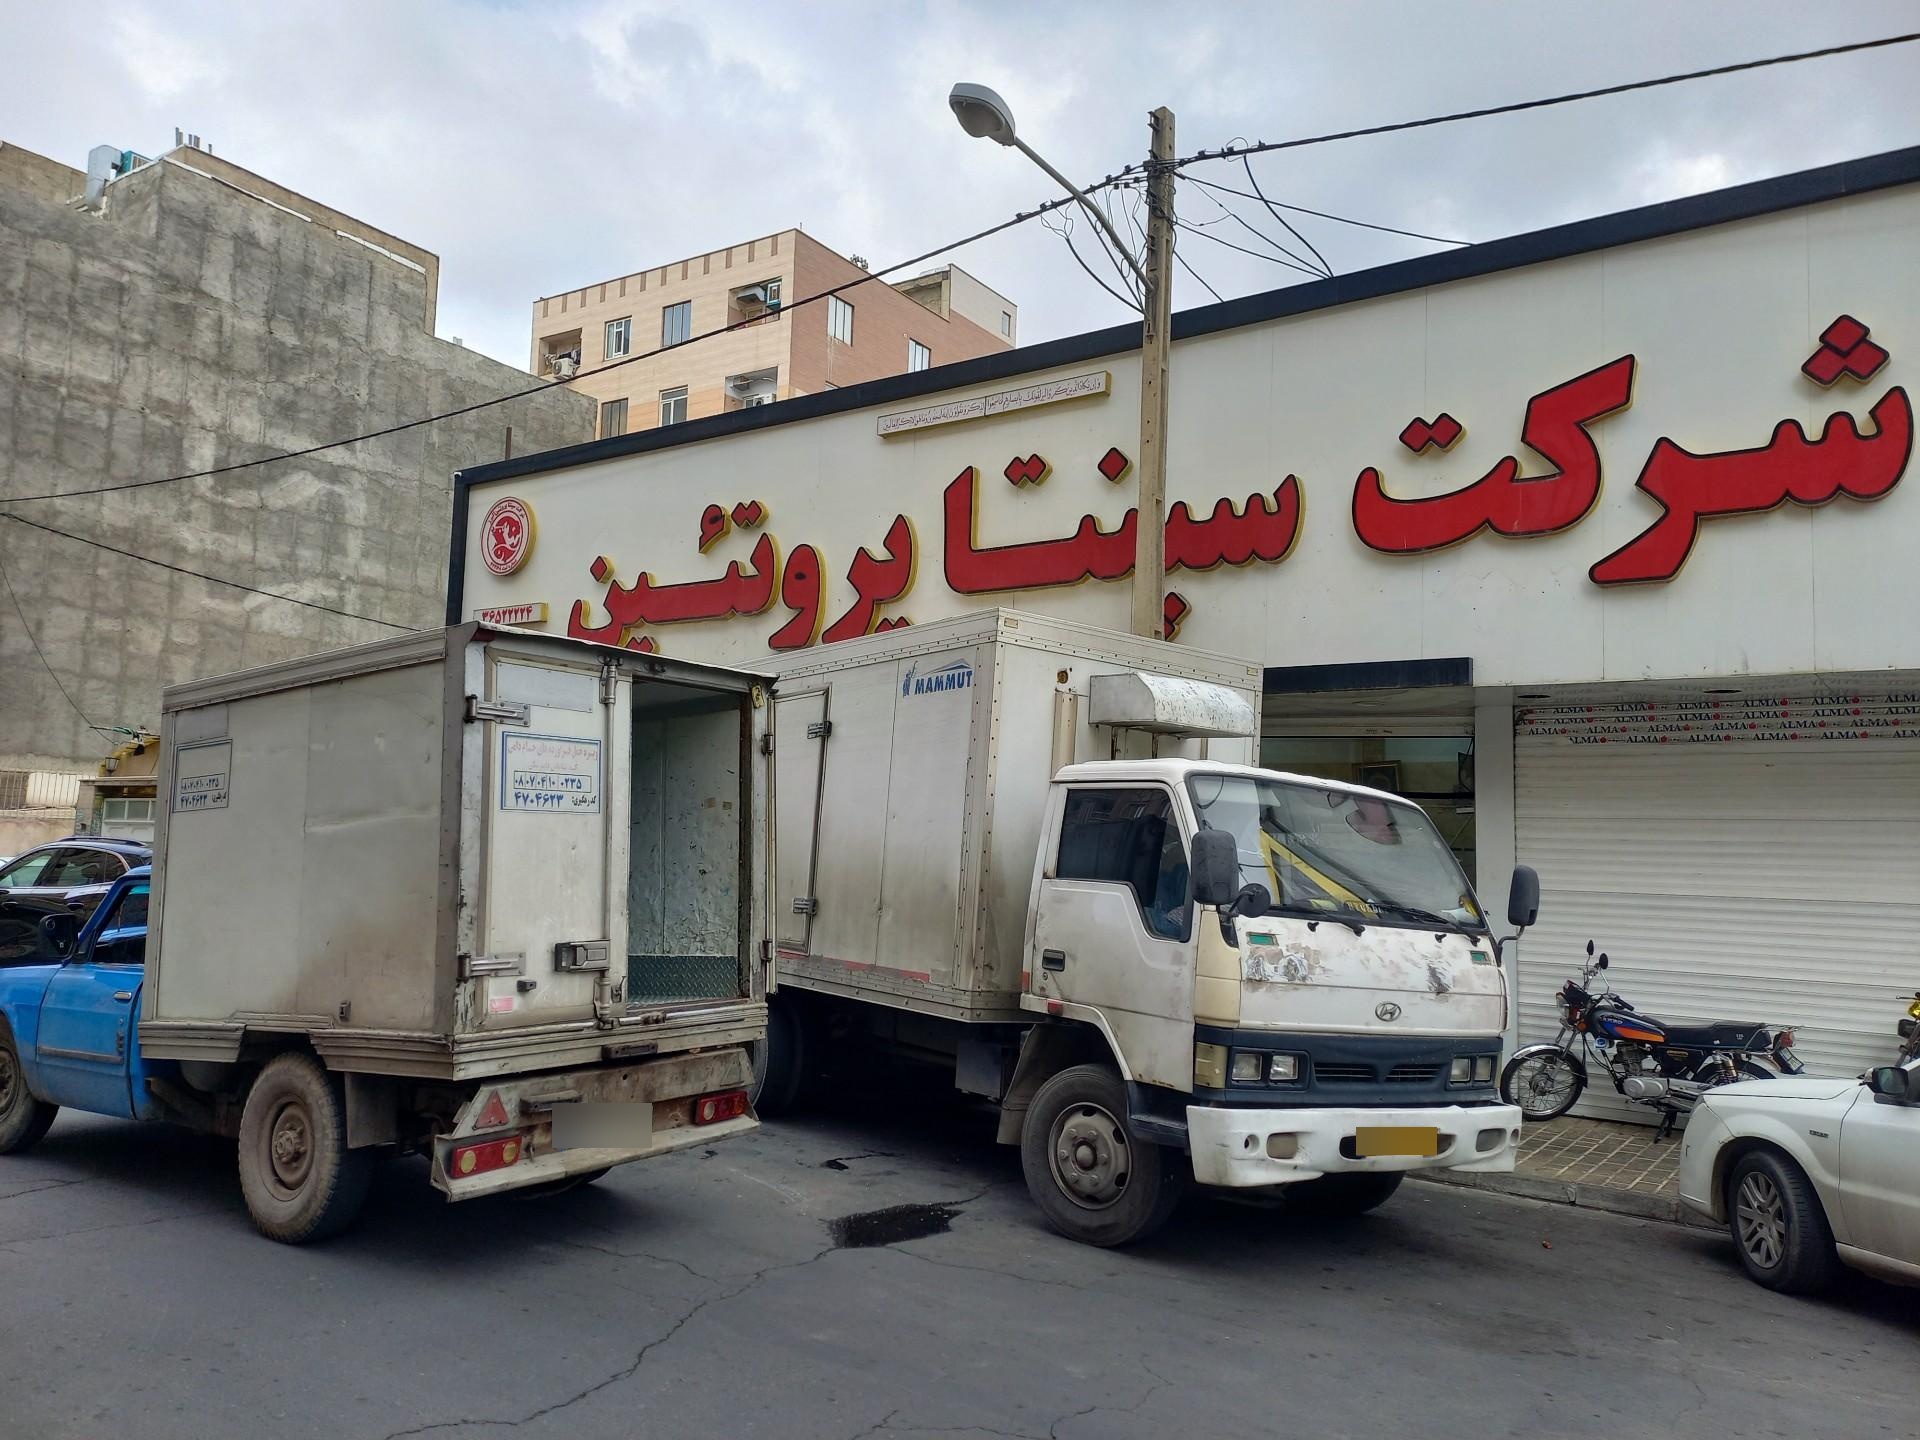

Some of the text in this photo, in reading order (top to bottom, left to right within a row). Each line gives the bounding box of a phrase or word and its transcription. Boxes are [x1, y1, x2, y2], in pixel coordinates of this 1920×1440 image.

[1352, 314, 1914, 586] شرکت
[914, 670, 973, 695] MAMMUT
[1741, 699, 1779, 708] ALMA
[1811, 696, 1851, 706] ALMA
[1885, 694, 1920, 703] ALM
[1743, 711, 1779, 720] ALMA
[1812, 708, 1851, 717] ALMA
[1528, 718, 1890, 736] ALMA ALMA ALMA ALMA ALMA ALMA
[1627, 735, 1659, 744] ALMA
[1688, 733, 1722, 743] ALMA
[1753, 732, 1789, 741] ALMA
[1821, 731, 1858, 740] ALMA
